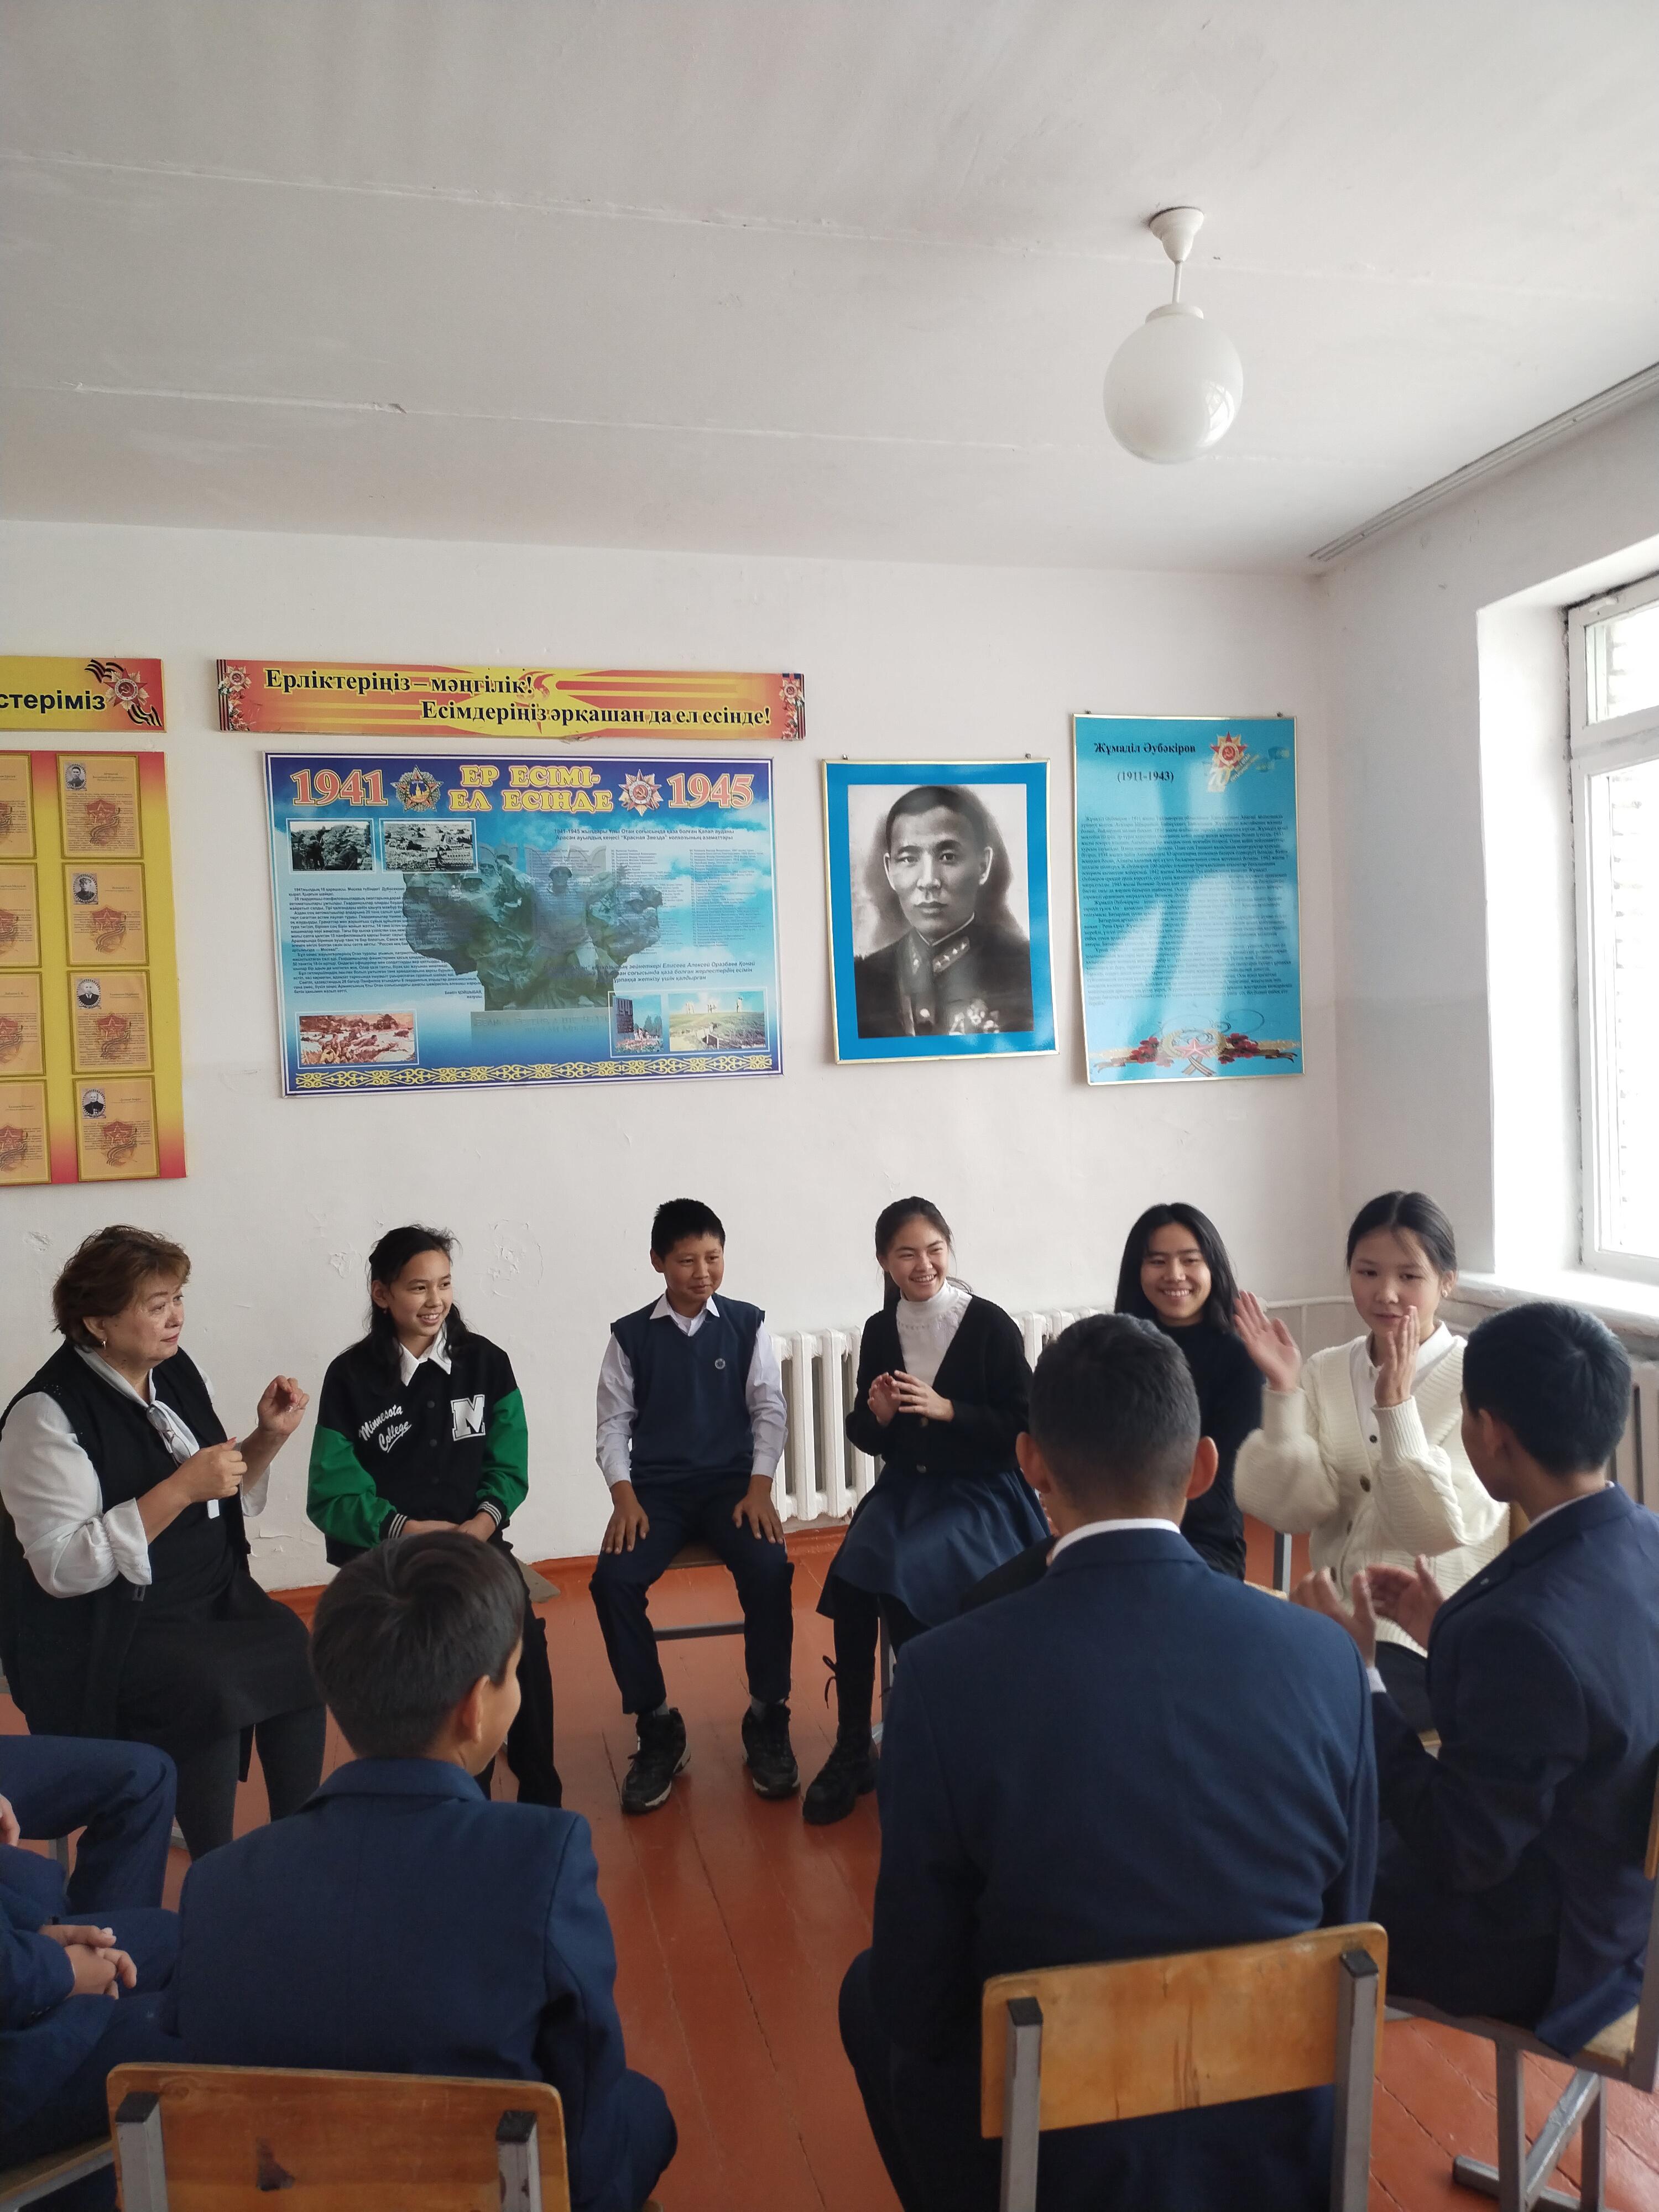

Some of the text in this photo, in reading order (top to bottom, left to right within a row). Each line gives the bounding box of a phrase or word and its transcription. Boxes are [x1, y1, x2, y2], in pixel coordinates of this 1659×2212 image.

[266, 669, 410, 694] Ерліктеріңіз
[431, 674, 533, 694] мәңгілік!
[0, 690, 105, 713] стеріміз
[422, 700, 771, 726] Есімдеріңіз әрқашан да ел есінде!
[291, 769, 388, 806] 1941
[461, 765, 499, 787] ЕР
[1118, 771, 1174, 783] (1911-1943)
[448, 789, 613, 813] ЕЛ ЕСІНДЕ
[667, 773, 754, 808] 1945
[358, 1405, 403, 1441] Minnesota
[378, 1421, 412, 1453] College
